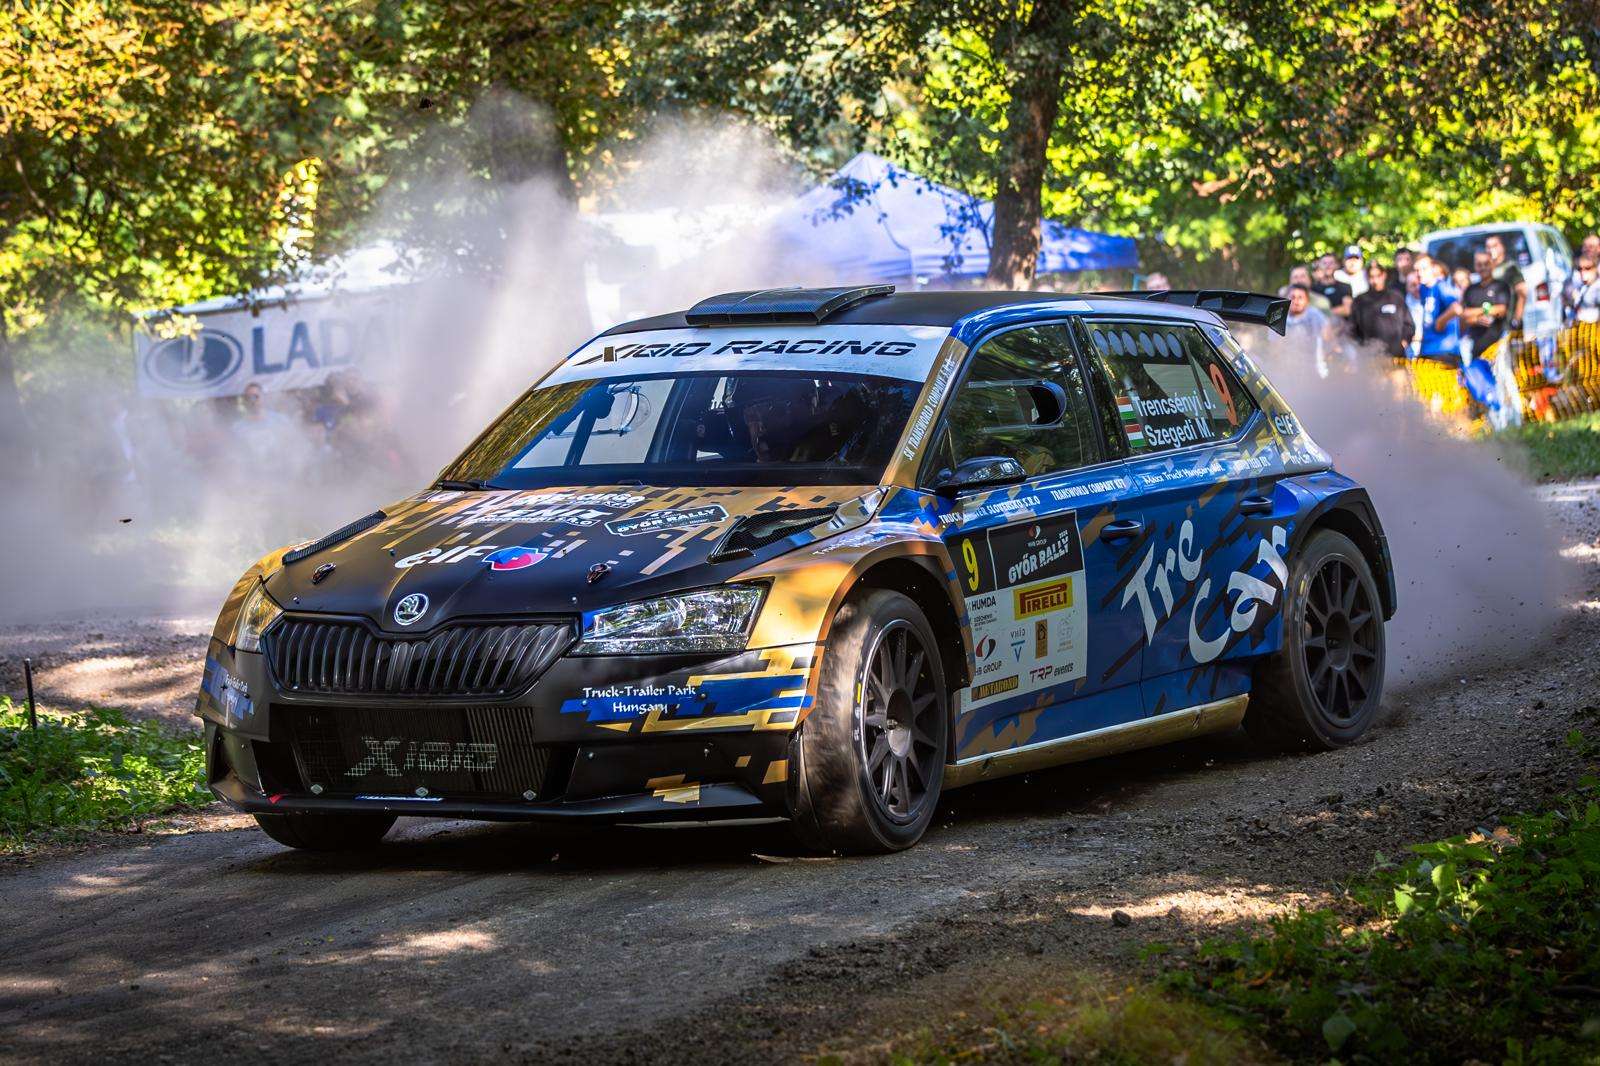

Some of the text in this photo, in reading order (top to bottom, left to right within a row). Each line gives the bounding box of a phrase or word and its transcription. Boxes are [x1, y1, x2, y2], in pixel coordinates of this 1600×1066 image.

[713, 340, 917, 357] RACING
[1131, 389, 1217, 417] Trencsényi J.
[1209, 363, 1238, 426] 9
[908, 404, 934, 449] TRANSWORLD
[927, 375, 947, 408] COMPANY
[1144, 416, 1216, 449] Szegedi M.
[1163, 469, 1184, 481] Truck
[1183, 466, 1212, 479] Hungary
[1050, 484, 1090, 500] TRANSWORLD
[1088, 480, 1115, 494] COMPANY
[666, 508, 716, 522] RALLY
[938, 511, 962, 524] TRUCK
[961, 538, 980, 592] 9
[1008, 536, 1070, 584] GYŐR RALLY
[1121, 519, 1203, 647] Tre
[971, 595, 997, 611] HUMDA
[1020, 582, 1068, 615] PIRELLI
[1188, 525, 1289, 664] Car
[983, 660, 1002, 674] GROUP
[1029, 662, 1074, 683] TRP events
[582, 684, 697, 698] Truck-Trailer Park
[612, 701, 668, 714] Hungary
